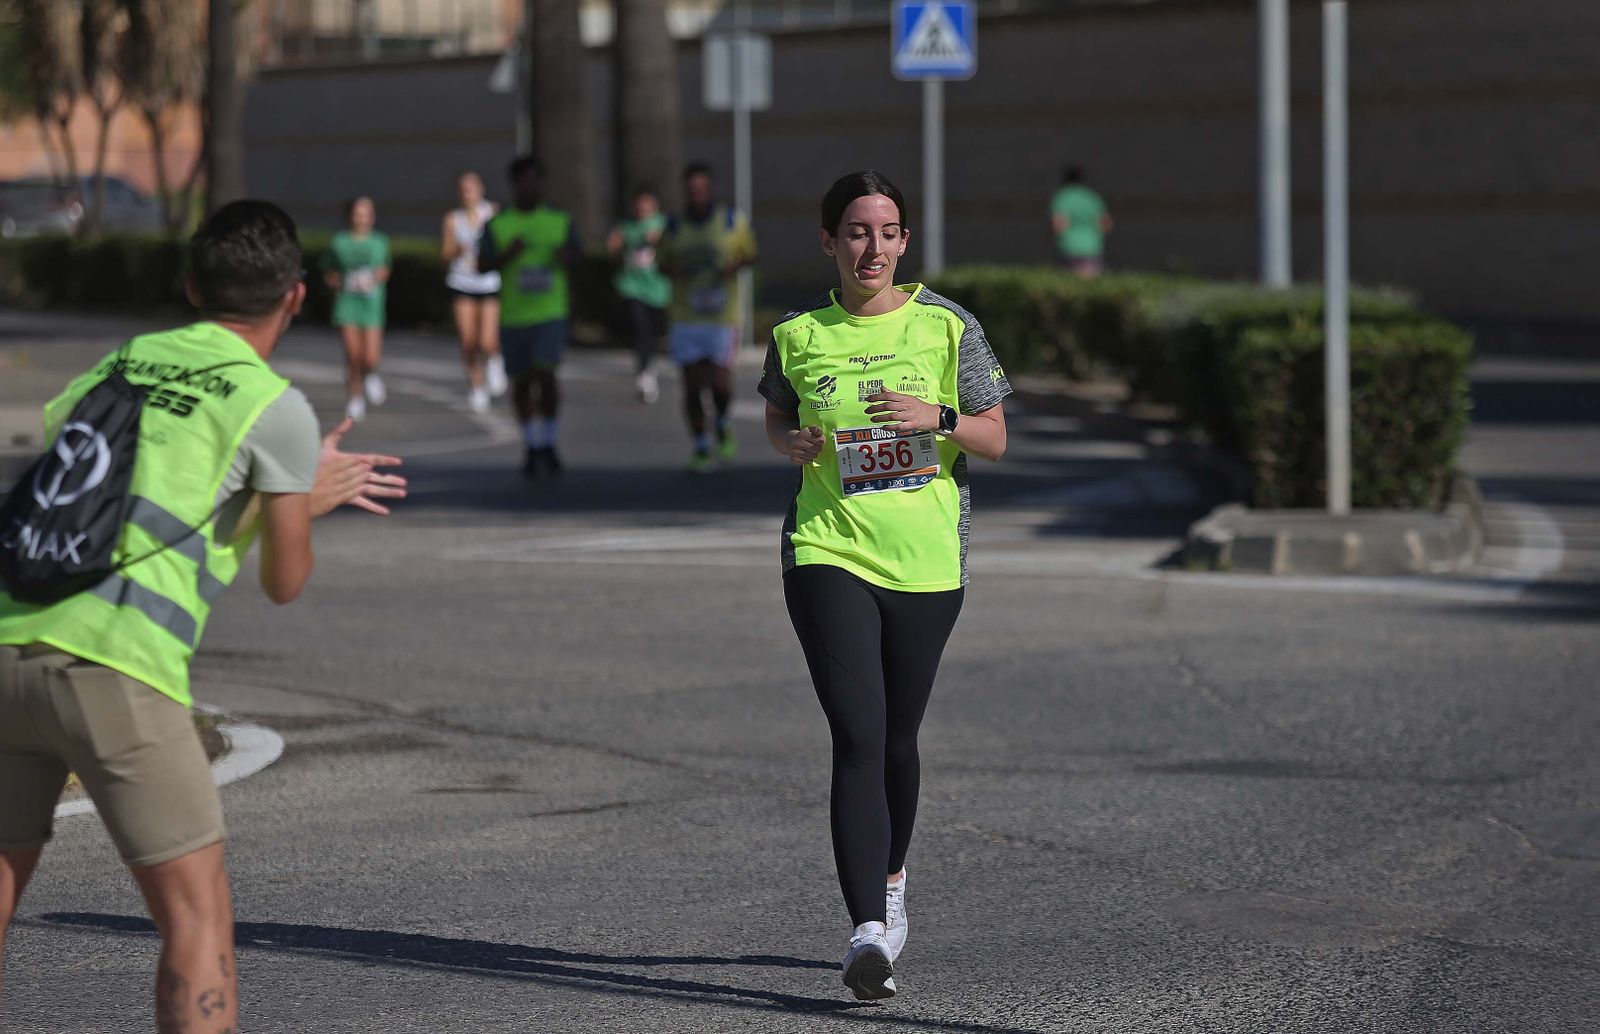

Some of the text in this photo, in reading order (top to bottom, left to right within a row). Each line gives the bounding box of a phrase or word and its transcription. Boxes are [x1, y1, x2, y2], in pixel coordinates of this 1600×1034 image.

[866, 379, 884, 388] PEOR
[871, 428, 896, 440] CROSS
[857, 440, 914, 473] 356
